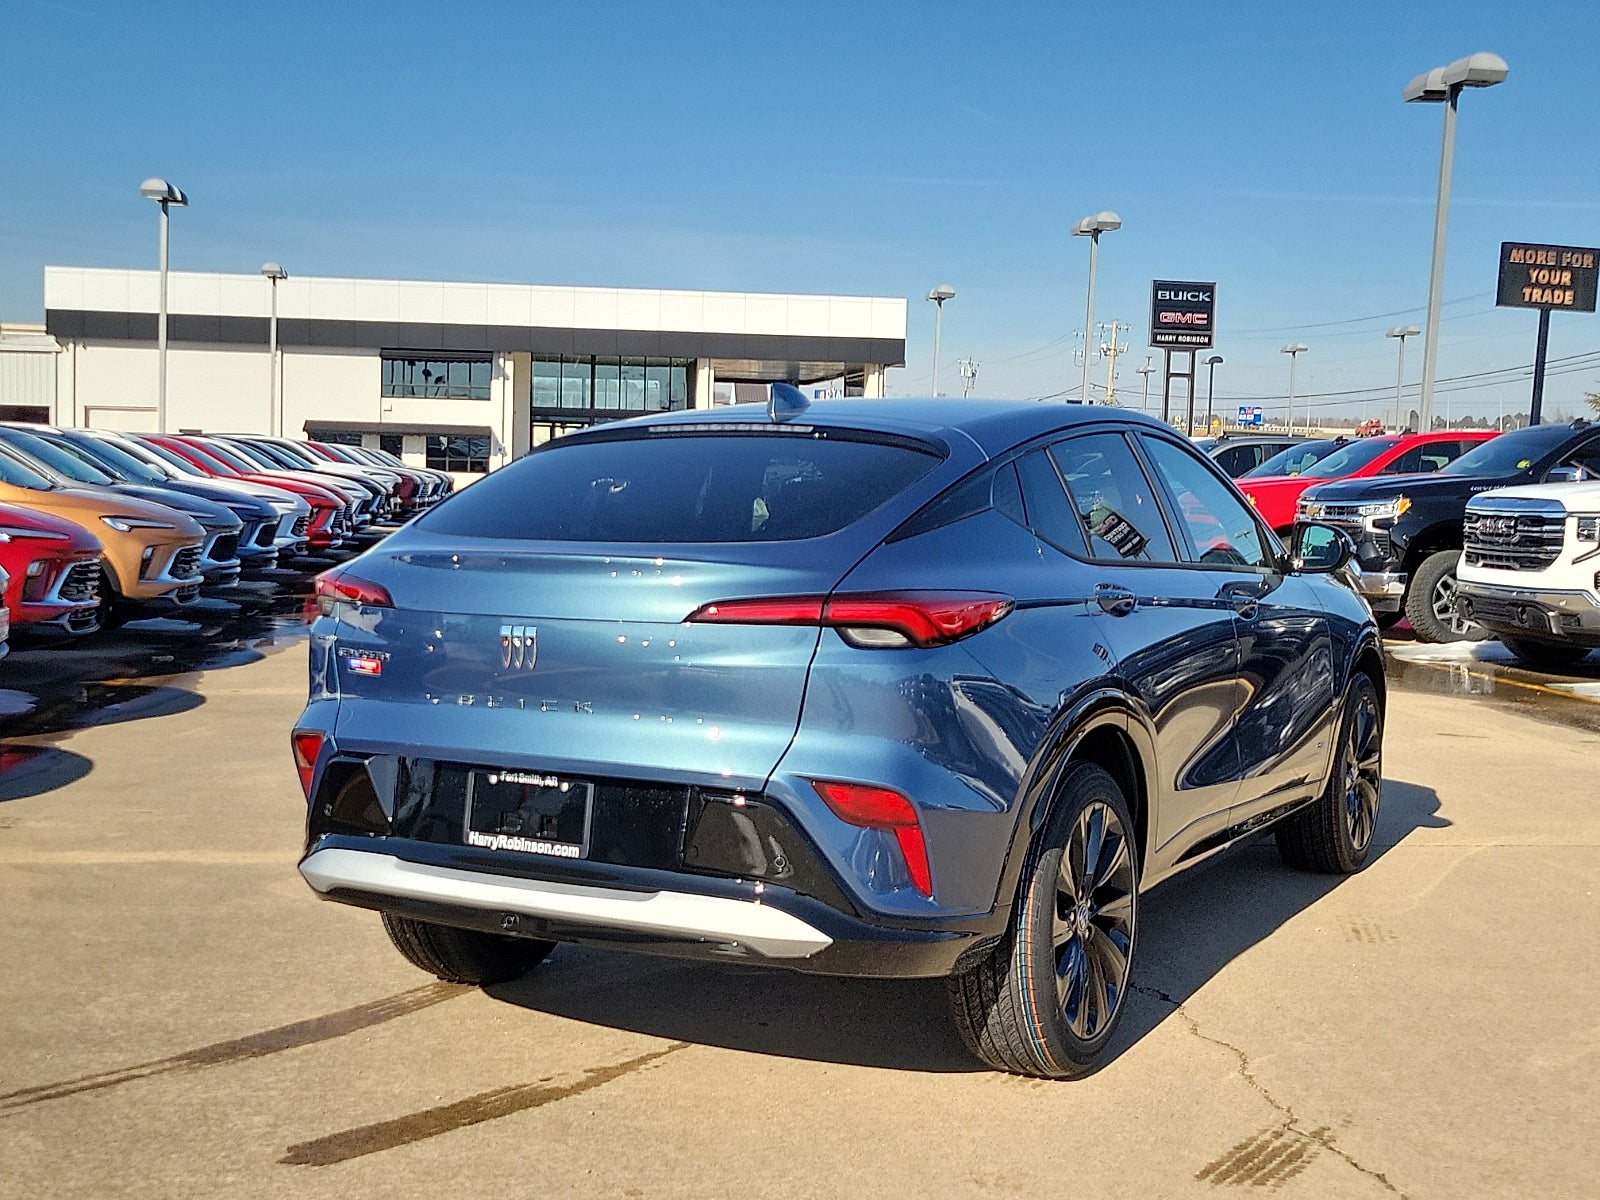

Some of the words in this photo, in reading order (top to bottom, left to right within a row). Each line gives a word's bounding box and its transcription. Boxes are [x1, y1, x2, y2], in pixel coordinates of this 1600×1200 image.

[1509, 248, 1557, 265] MORE
[1561, 251, 1593, 268] FOR
[1529, 267, 1571, 285] YOUR
[1157, 290, 1211, 302] BUICK
[1522, 286, 1575, 305] TRADE
[1159, 312, 1208, 324] GMC
[1156, 334, 1177, 342] HARRY
[1178, 335, 1209, 343] ROBINSON
[458, 694, 594, 714] BUICK
[500, 770, 518, 783] Fort
[518, 772, 545, 787] Smith,
[468, 831, 580, 858] HarryRobinson.com
